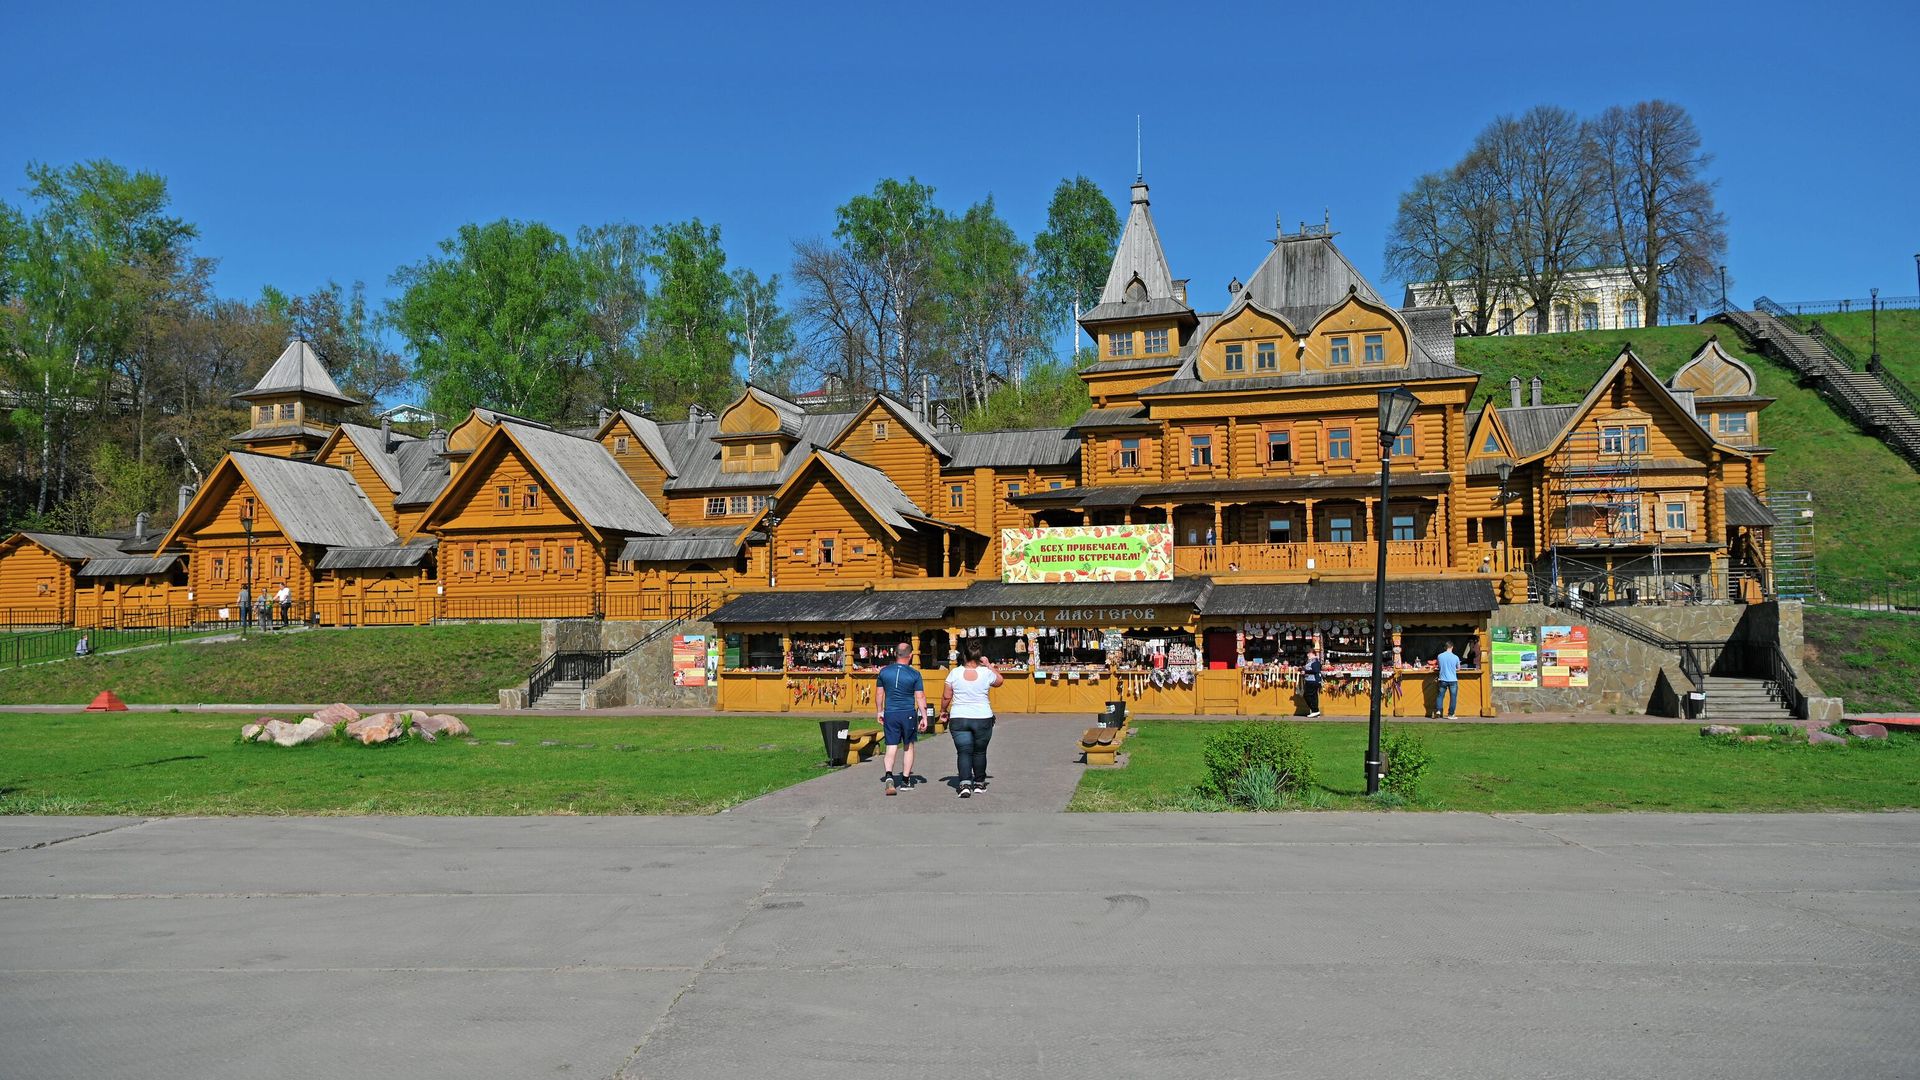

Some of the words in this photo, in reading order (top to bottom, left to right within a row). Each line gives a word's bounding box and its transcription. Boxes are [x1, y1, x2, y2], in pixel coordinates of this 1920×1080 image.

[1040, 543, 1064, 553] ВСЕХ
[1029, 553, 1075, 566] ДУШЕВНО
[1079, 552, 1141, 562] ВСТРЕЧАЕМ!
[991, 610, 1046, 622] ГОРОД
[1054, 608, 1155, 620] МАСТЕРОВ
